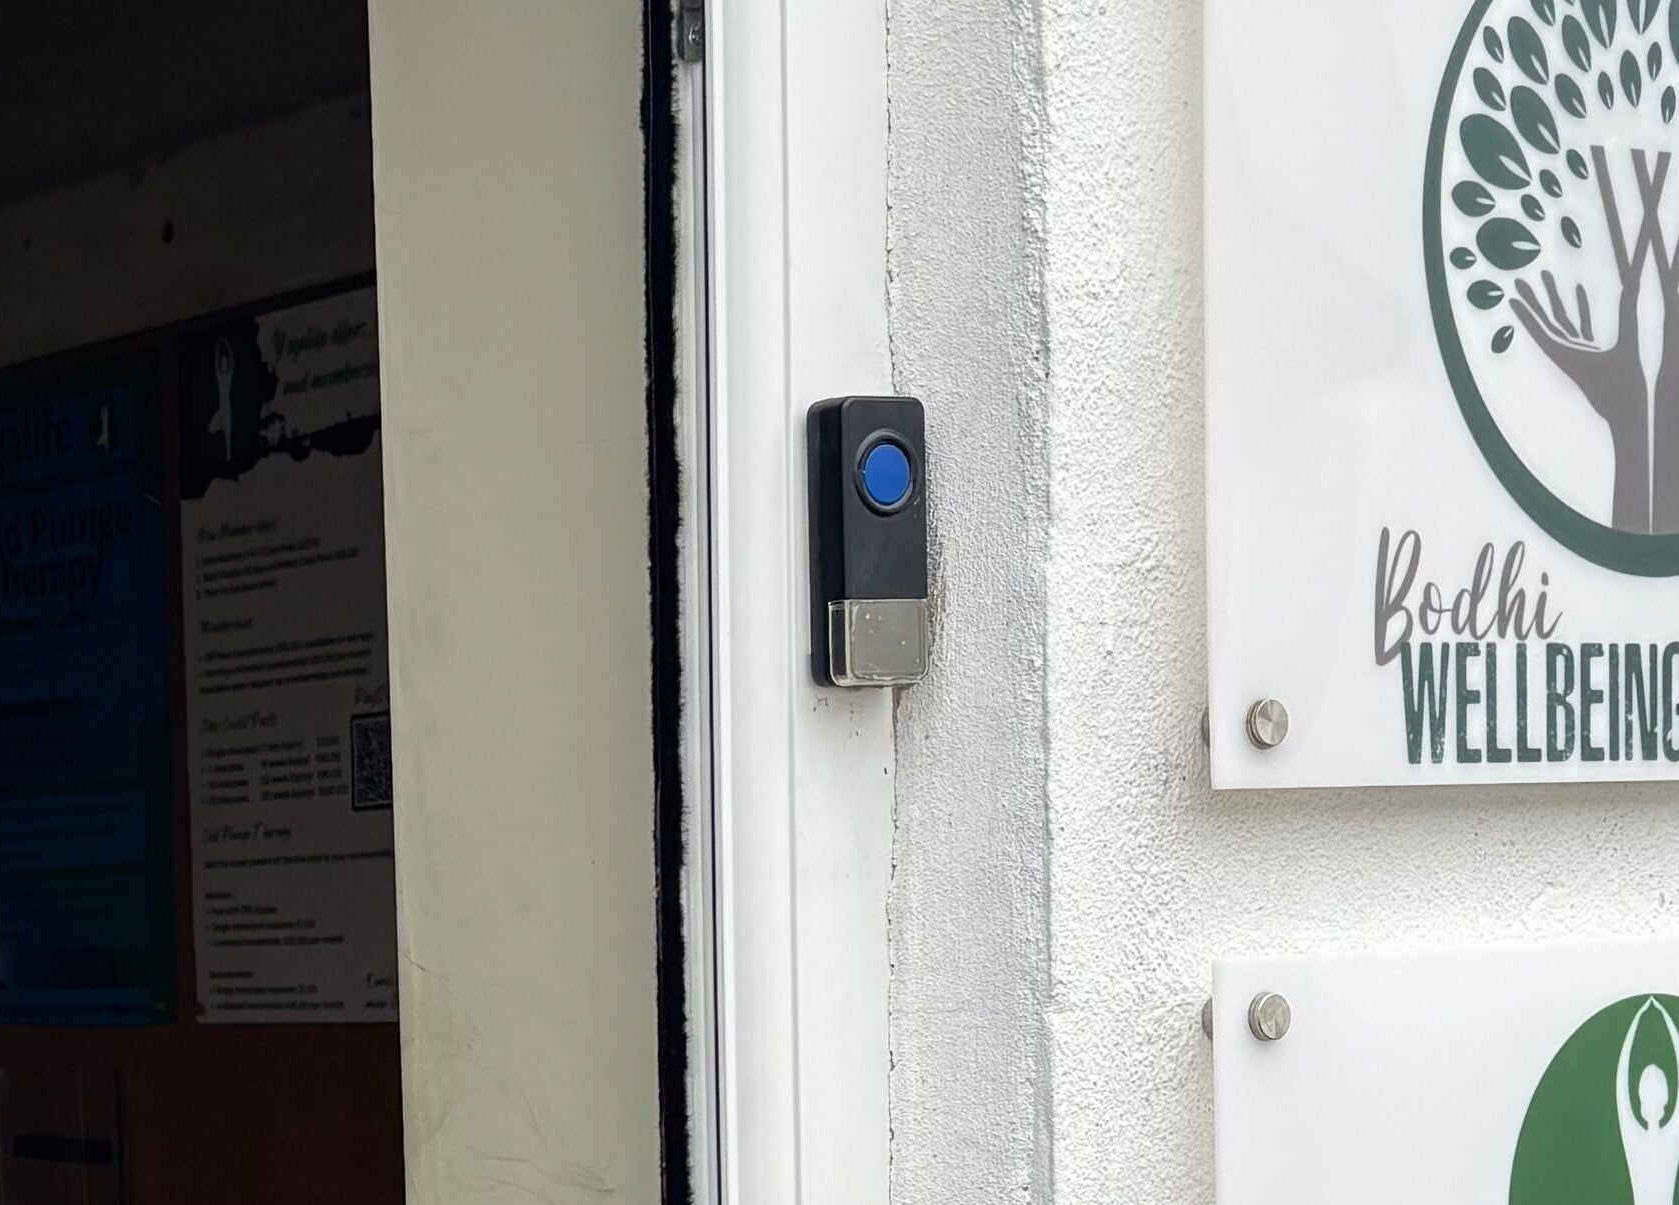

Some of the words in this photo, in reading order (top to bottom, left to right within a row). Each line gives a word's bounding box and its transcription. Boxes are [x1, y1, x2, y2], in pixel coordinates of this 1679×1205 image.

[31, 500, 132, 555] Plunge
[1374, 527, 1563, 667] Bodhi
[1401, 641, 1679, 764] WELLBEING
